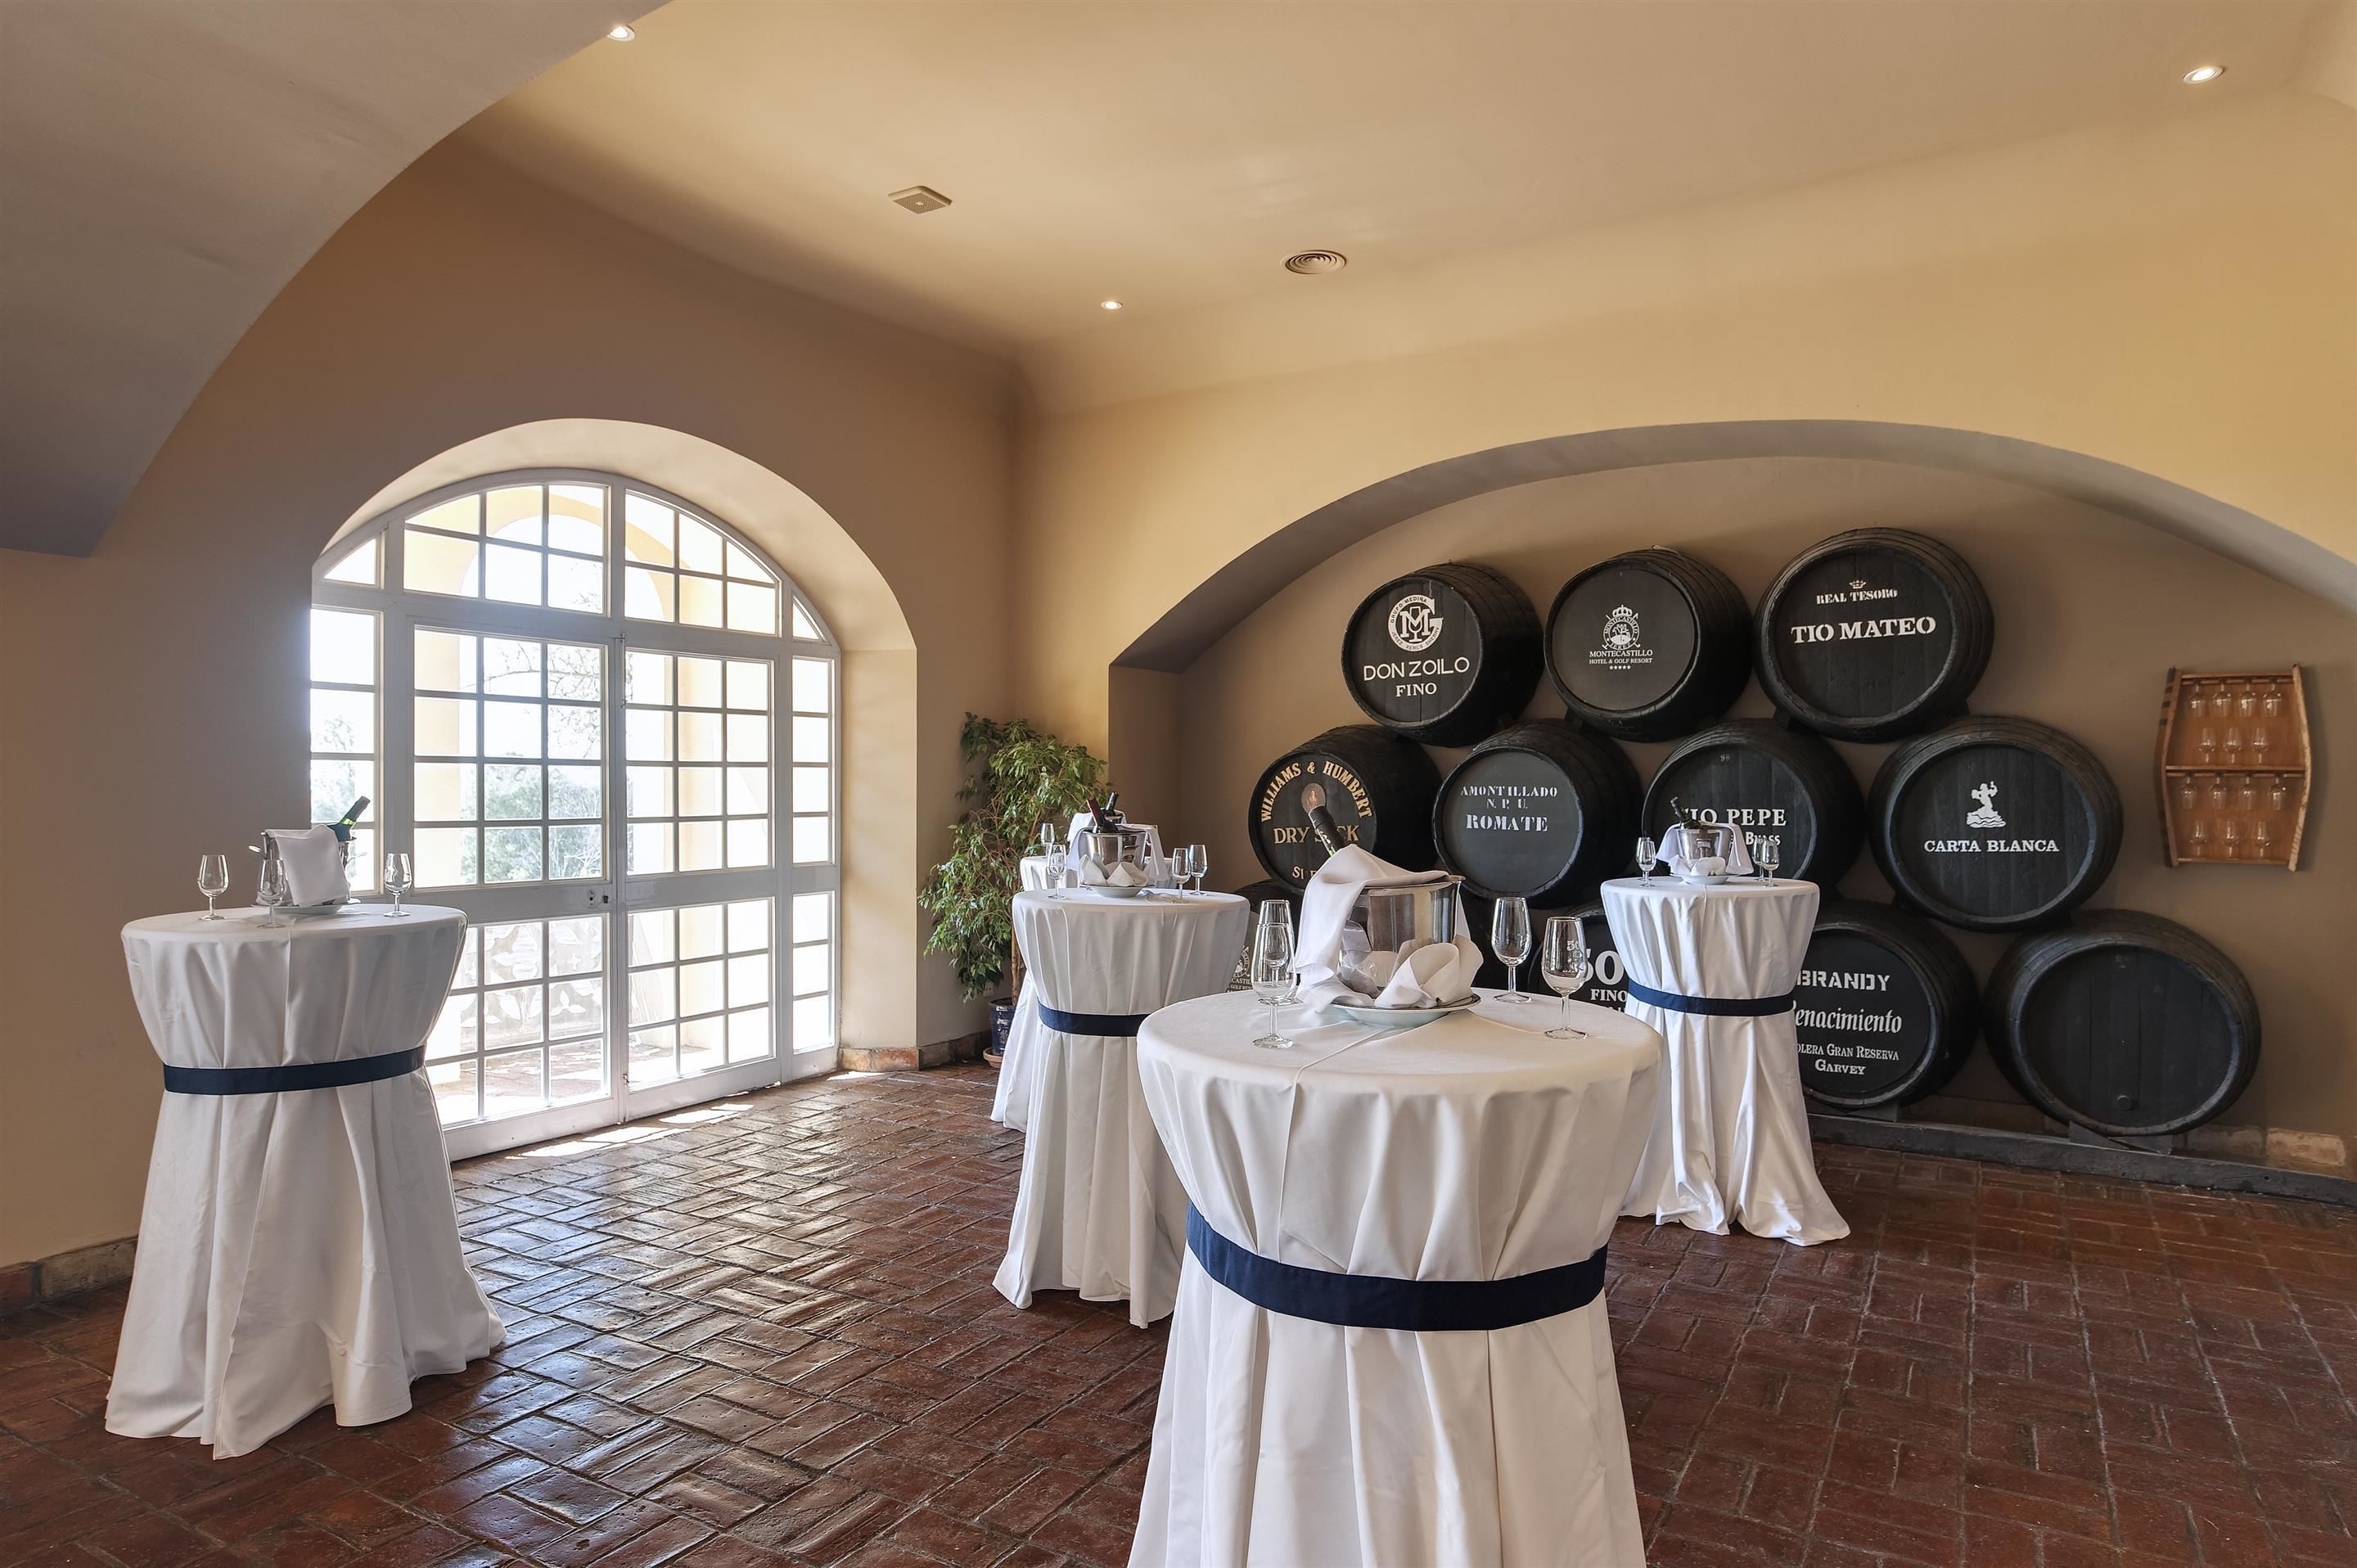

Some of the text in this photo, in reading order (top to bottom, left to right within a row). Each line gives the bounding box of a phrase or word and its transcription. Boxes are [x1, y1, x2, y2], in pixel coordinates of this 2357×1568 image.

[1404, 596, 1427, 604] MEDINA
[1816, 588, 1899, 605] REAL TESORO
[1791, 616, 1936, 643] TIO MATEO
[1589, 649, 1653, 658] MONTECASTILLO
[1363, 656, 1470, 681] DON ZOILO
[1395, 682, 1437, 697] FINO
[1261, 760, 1372, 822] WILLIAMS & HUMBERT
[1466, 814, 1548, 831] ROMATE
[1726, 808, 1787, 827] PEPE
[1273, 826, 1310, 845] DRY
[1924, 840, 2060, 853] CARTA BLANCA
[1796, 970, 1891, 992] BRANDY
[1590, 989, 1628, 1003] FINO
[1792, 1000, 1903, 1034] enacimiento
[1826, 1043, 1854, 1057] GRAN
[1856, 1045, 1900, 1061] RESERVA
[1814, 1059, 1867, 1075] GARVEY
